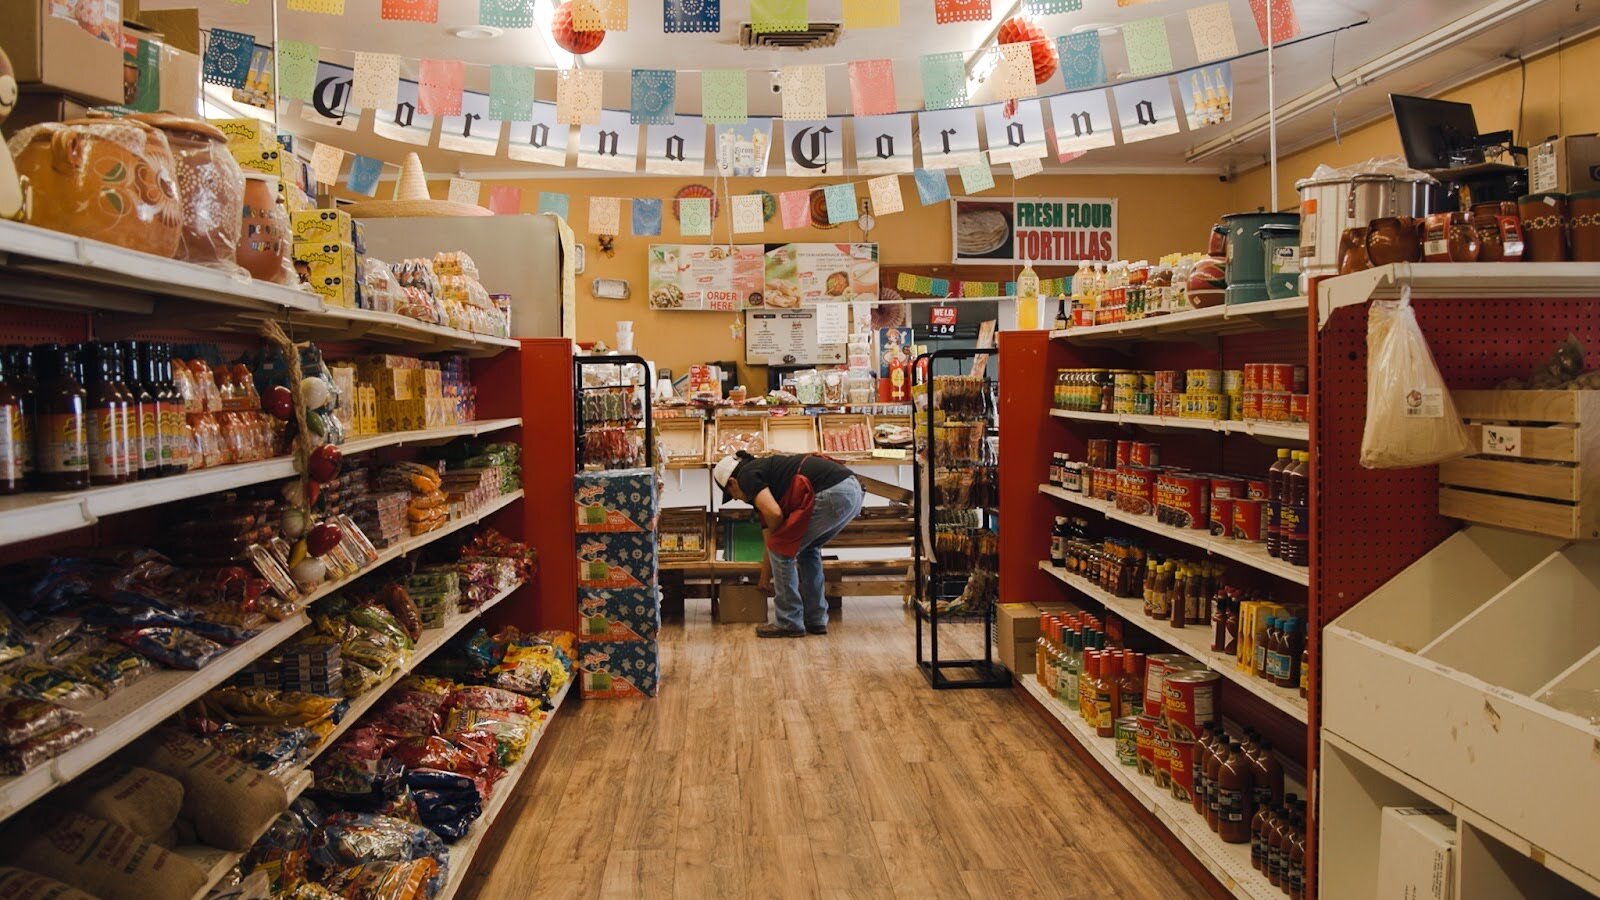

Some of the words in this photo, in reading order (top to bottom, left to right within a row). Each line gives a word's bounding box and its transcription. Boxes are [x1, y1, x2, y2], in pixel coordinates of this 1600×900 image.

[312, 76, 687, 164] Corona
[791, 97, 1158, 175] Corona
[1016, 202, 1062, 228] FRESH
[1066, 203, 1112, 228] FLOUR
[1016, 230, 1112, 262] TORTILLAS
[706, 291, 737, 301] ORDER
[710, 301, 733, 310] HERE
